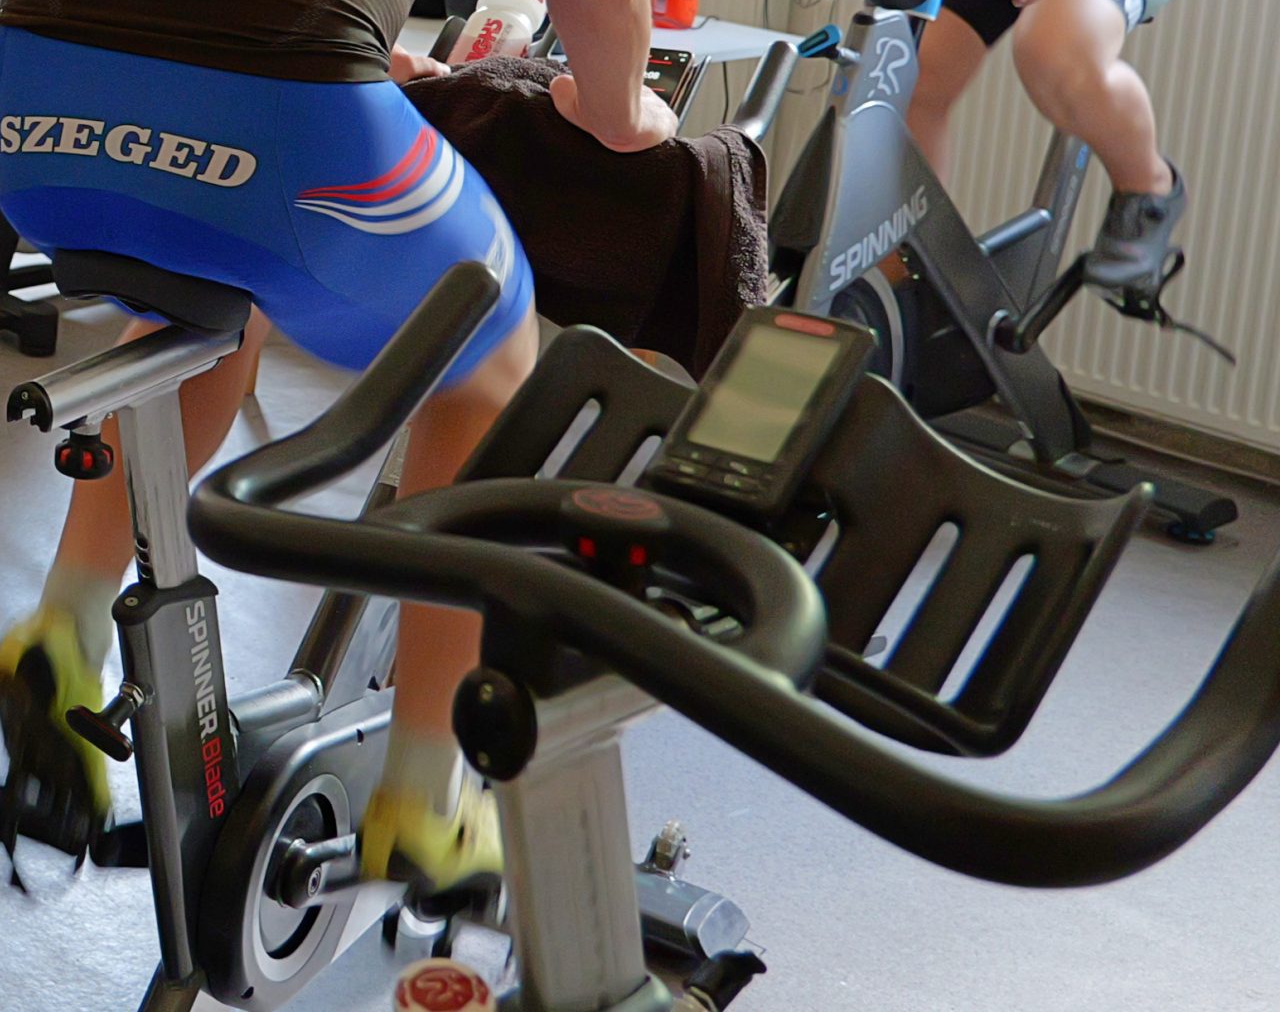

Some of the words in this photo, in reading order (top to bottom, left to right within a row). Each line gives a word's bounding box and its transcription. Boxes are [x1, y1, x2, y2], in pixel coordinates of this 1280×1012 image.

[0, 115, 258, 188] SZEGED
[828, 185, 928, 292] SPINNING
[184, 599, 219, 740] SPINNER
[201, 737, 227, 820] Blade
